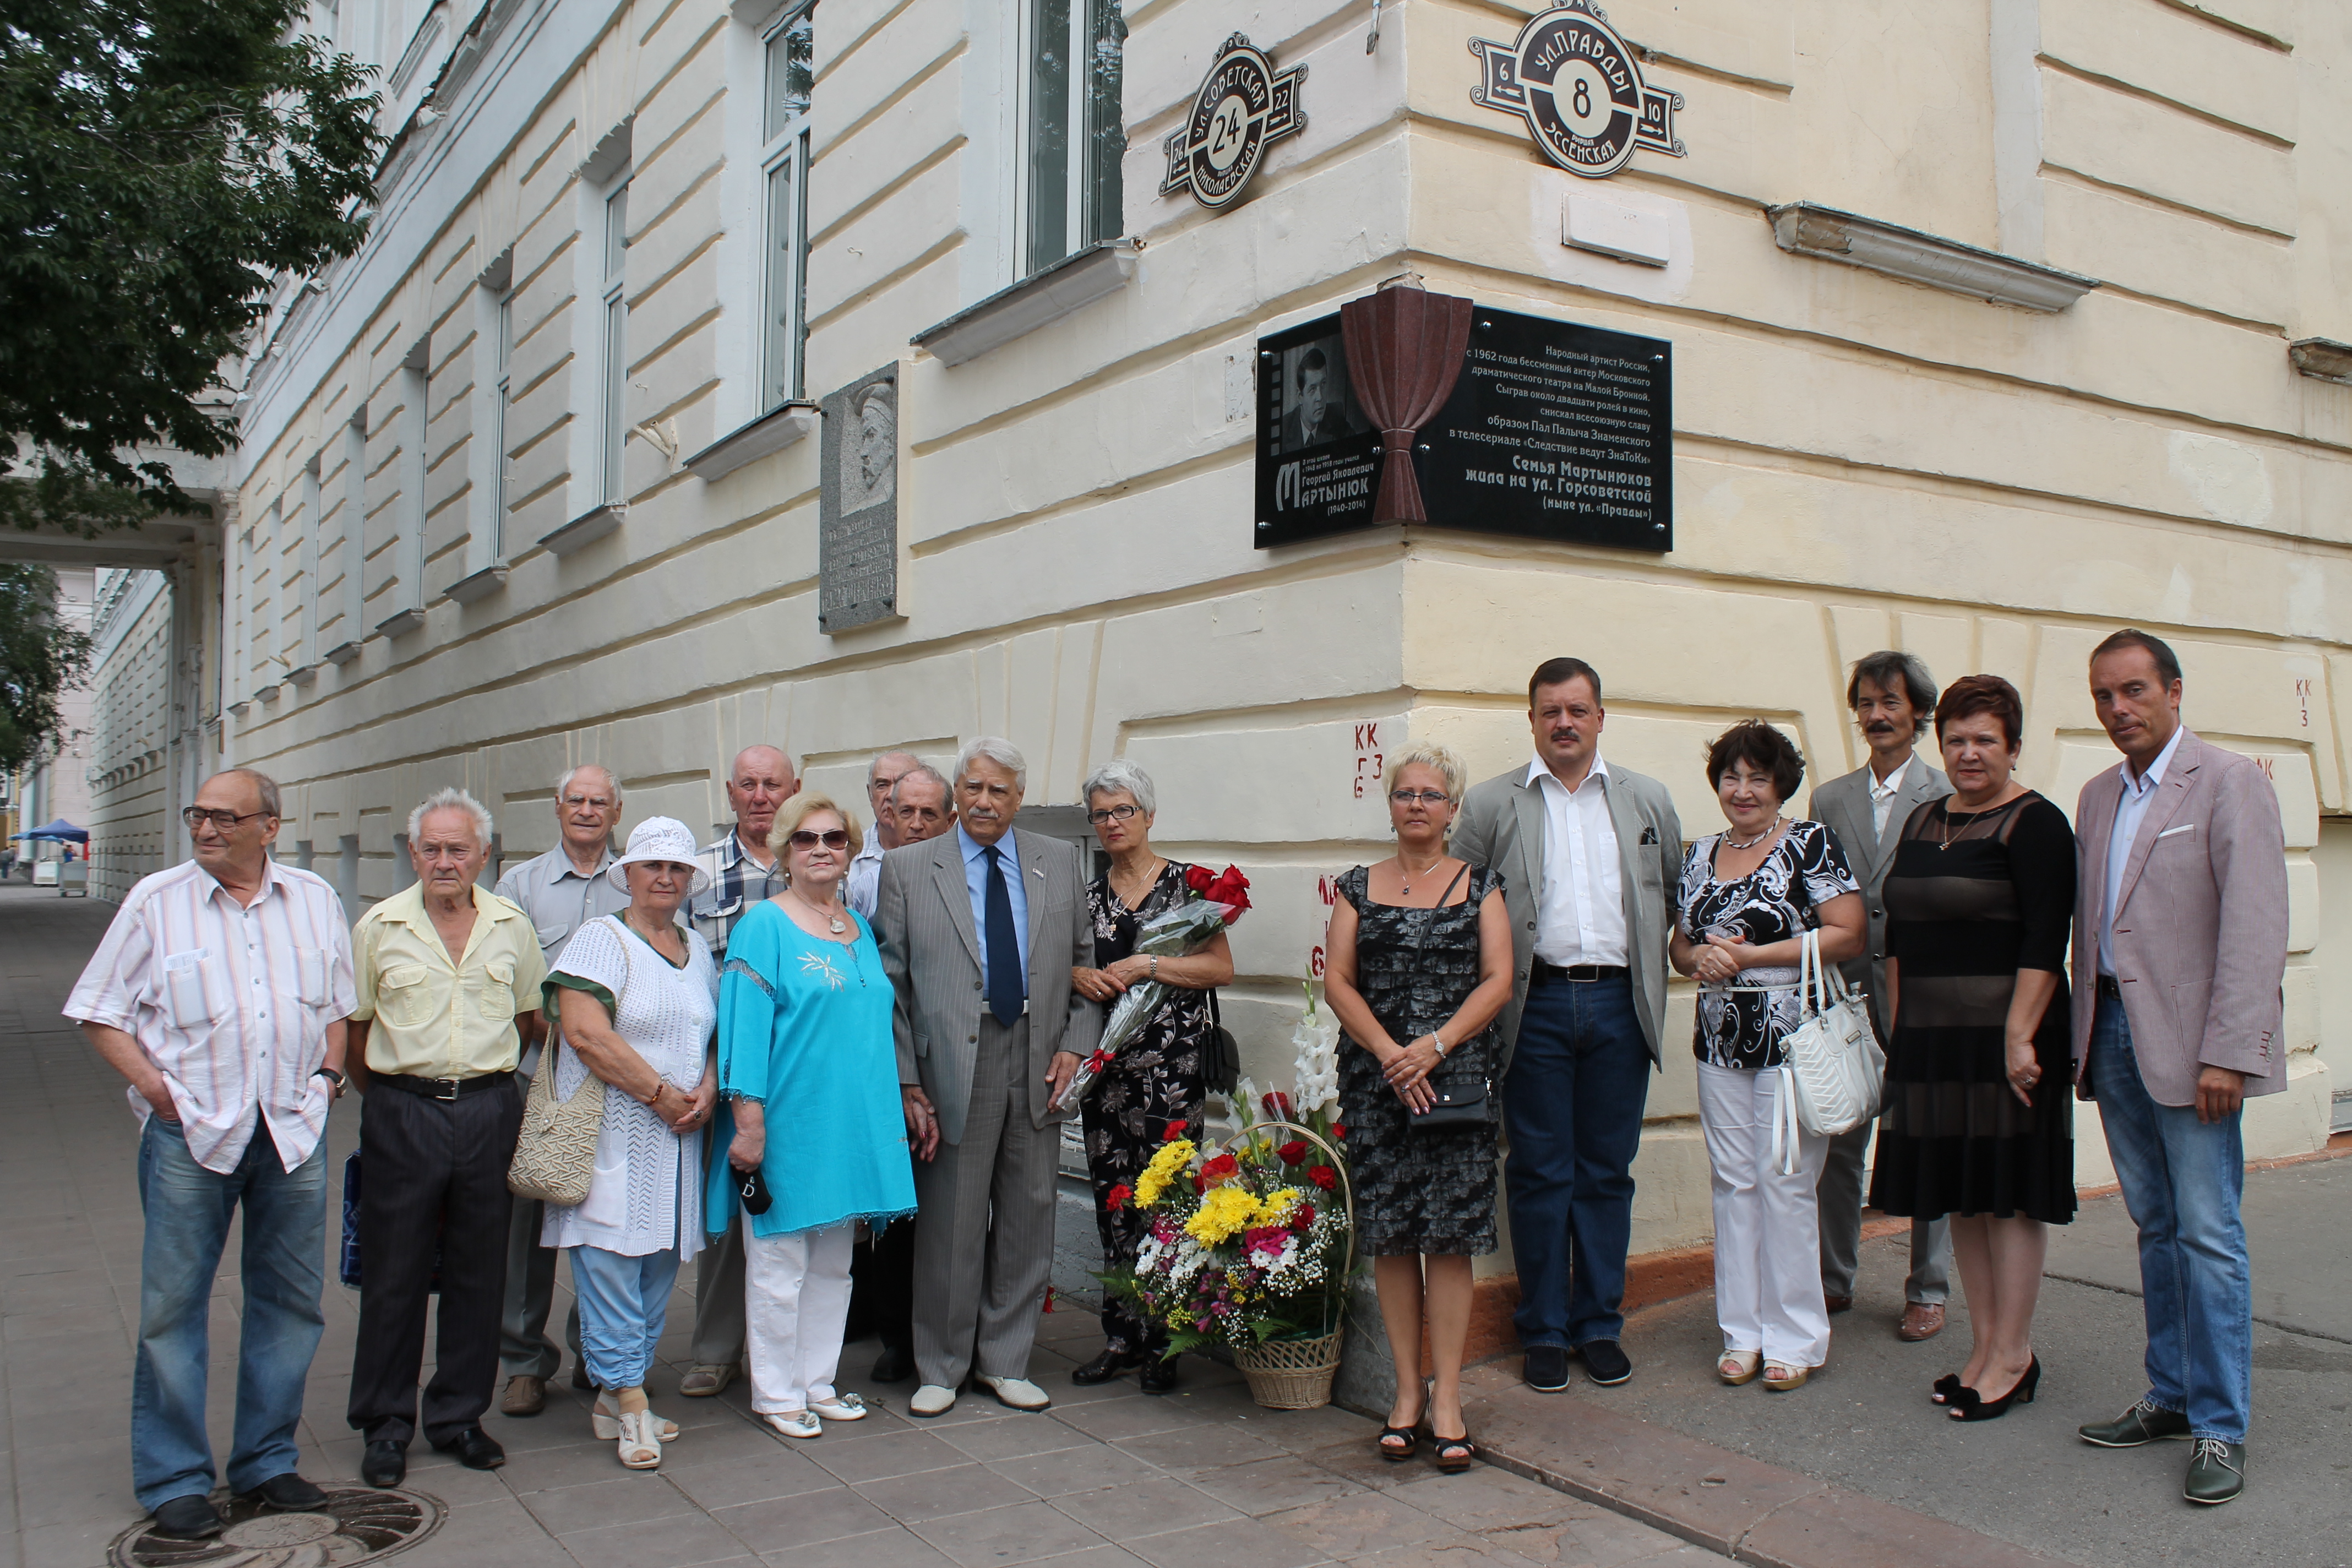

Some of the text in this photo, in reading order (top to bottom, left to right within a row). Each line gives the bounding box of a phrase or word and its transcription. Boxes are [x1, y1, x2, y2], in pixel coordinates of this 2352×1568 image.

[1204, 66, 1265, 108] СОВЕТСКАЯ
[1499, 63, 1509, 81] 6
[1275, 90, 1288, 110] 22
[1573, 78, 1591, 118] 8
[1648, 102, 1660, 122] 10
[1212, 107, 1240, 154] 24
[1544, 121, 1616, 163] ЭССЕНСКАЯ
[1173, 148, 1183, 164] 26
[1196, 140, 1256, 194] НИКОЛАЕВСКАЯ
[1474, 349, 1496, 361] 1962
[1498, 355, 1517, 364] года
[1520, 357, 1571, 373] бессменный
[1574, 367, 1596, 379] актер
[1598, 369, 1650, 386] Московского
[1546, 345, 1650, 373] Народный артист России,
[1472, 366, 1650, 401] драматического театра на Малой Бронной.
[1496, 383, 1528, 398] Сыграв
[1531, 391, 1555, 401] около
[1556, 395, 1595, 407] двадцати
[1597, 401, 1620, 412] ролей
[1629, 407, 1650, 417] кино,
[1488, 415, 1650, 448] образом Пал Палыча Знаменского
[1540, 408, 1651, 433] снискал всесоюзную славу
[1457, 430, 1521, 445] телесериале
[1523, 438, 1578, 454] «Следствие
[1580, 447, 1605, 460] ведут
[1608, 449, 1650, 464] ЗнаТоКи»
[1302, 463, 1374, 487] Георгий Яковлевич
[1466, 469, 1652, 503] жила на ул. Горсоветской
[1513, 455, 1652, 487] Семья Мартынюков
[1327, 499, 1365, 516] (1940-2014)
[1543, 496, 1652, 521] (ныне ул. «Правды»)
[2301, 709, 2307, 727] 3
[1311, 945, 1325, 977] 6
[742, 1183, 755, 1197] D
